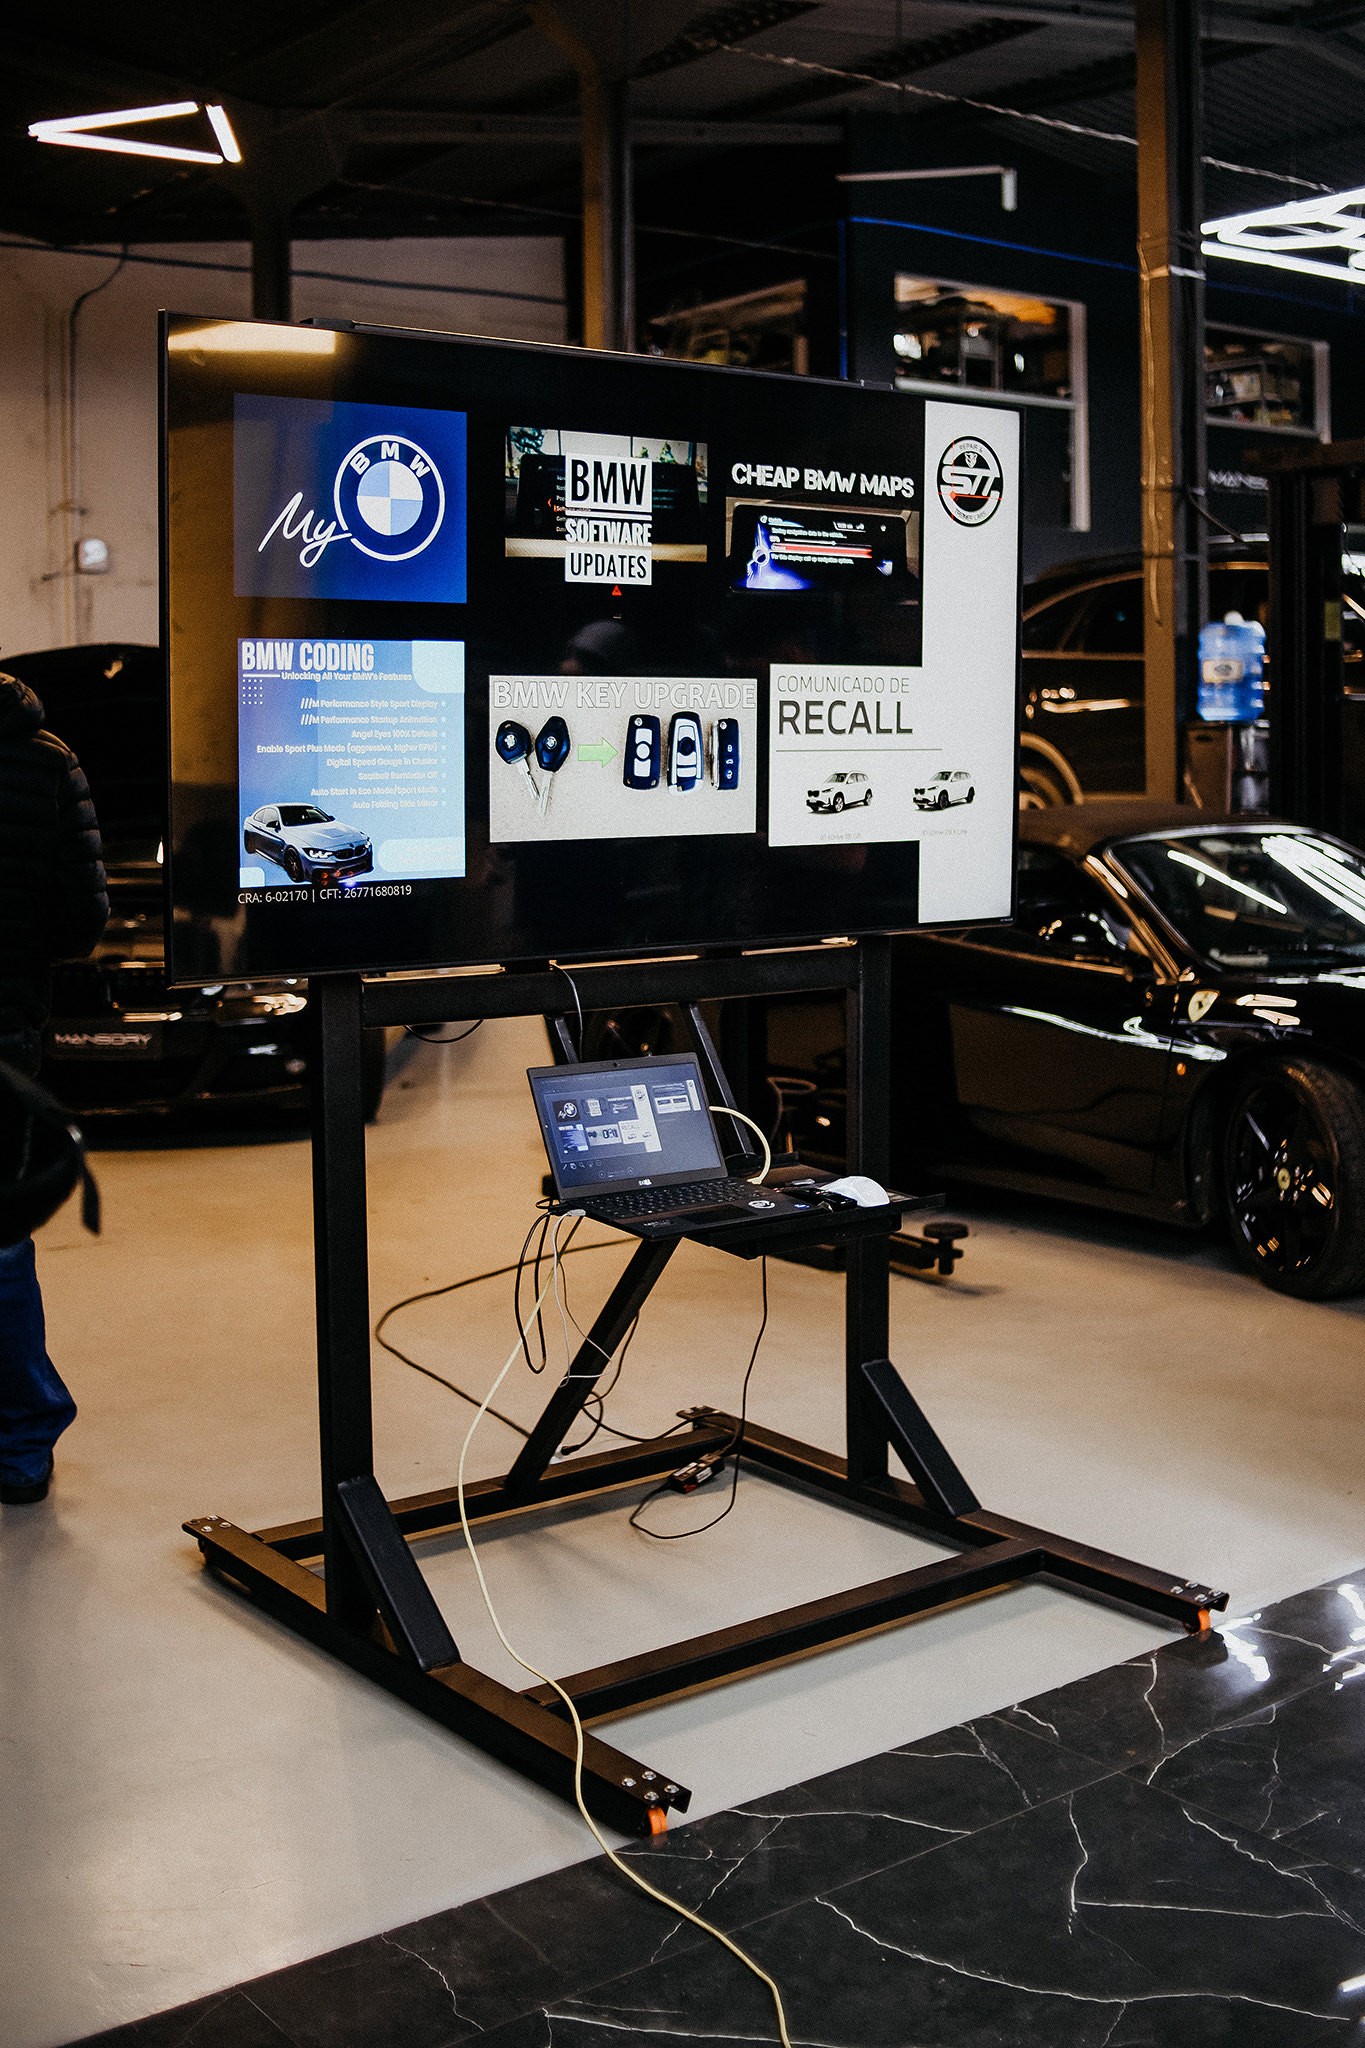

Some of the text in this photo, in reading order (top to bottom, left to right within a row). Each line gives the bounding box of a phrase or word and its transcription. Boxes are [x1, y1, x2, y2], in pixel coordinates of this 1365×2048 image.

[350, 442, 431, 478] BMW
[571, 459, 647, 506] BMW
[731, 463, 915, 498] CHEAP BMW MAPS
[258, 491, 352, 568] My
[564, 517, 653, 547] SOFTWARE
[570, 552, 647, 579] UPDATES
[241, 641, 375, 672] BMW CODING
[281, 671, 321, 683] Unlocking
[322, 672, 332, 681] All
[333, 672, 352, 681] Your
[379, 672, 413, 681] Features
[777, 675, 910, 694] COMUNICADO DE
[320, 699, 369, 708] Performance
[370, 699, 391, 710] Style
[392, 699, 411, 710] Sport
[411, 699, 438, 710] Display
[493, 680, 756, 710] BMW KEY UPGRADE
[320, 715, 369, 724] Performance
[370, 715, 398, 726] Startup
[400, 715, 438, 724] Animation
[778, 700, 913, 735] RECALL
[351, 730, 374, 740] Angel
[374, 730, 392, 740] Eyes
[256, 744, 284, 754] Enable
[284, 744, 306, 755] Sport
[306, 744, 323, 753] Plus
[323, 743, 345, 753] Mode
[326, 757, 351, 769] Digital
[352, 757, 377, 769] Speed
[310, 787, 329, 797] Auto
[330, 787, 349, 796] Start
[358, 786, 373, 795] Eco
[417, 786, 438, 795] Mode
[352, 800, 371, 810] Auto
[371, 800, 399, 810] Folding
[399, 799, 416, 809] Side
[237, 893, 263, 904] CRA:
[265, 890, 308, 903] 6-02170
[319, 888, 342, 901] CFT:
[344, 885, 412, 899] 26771680819
